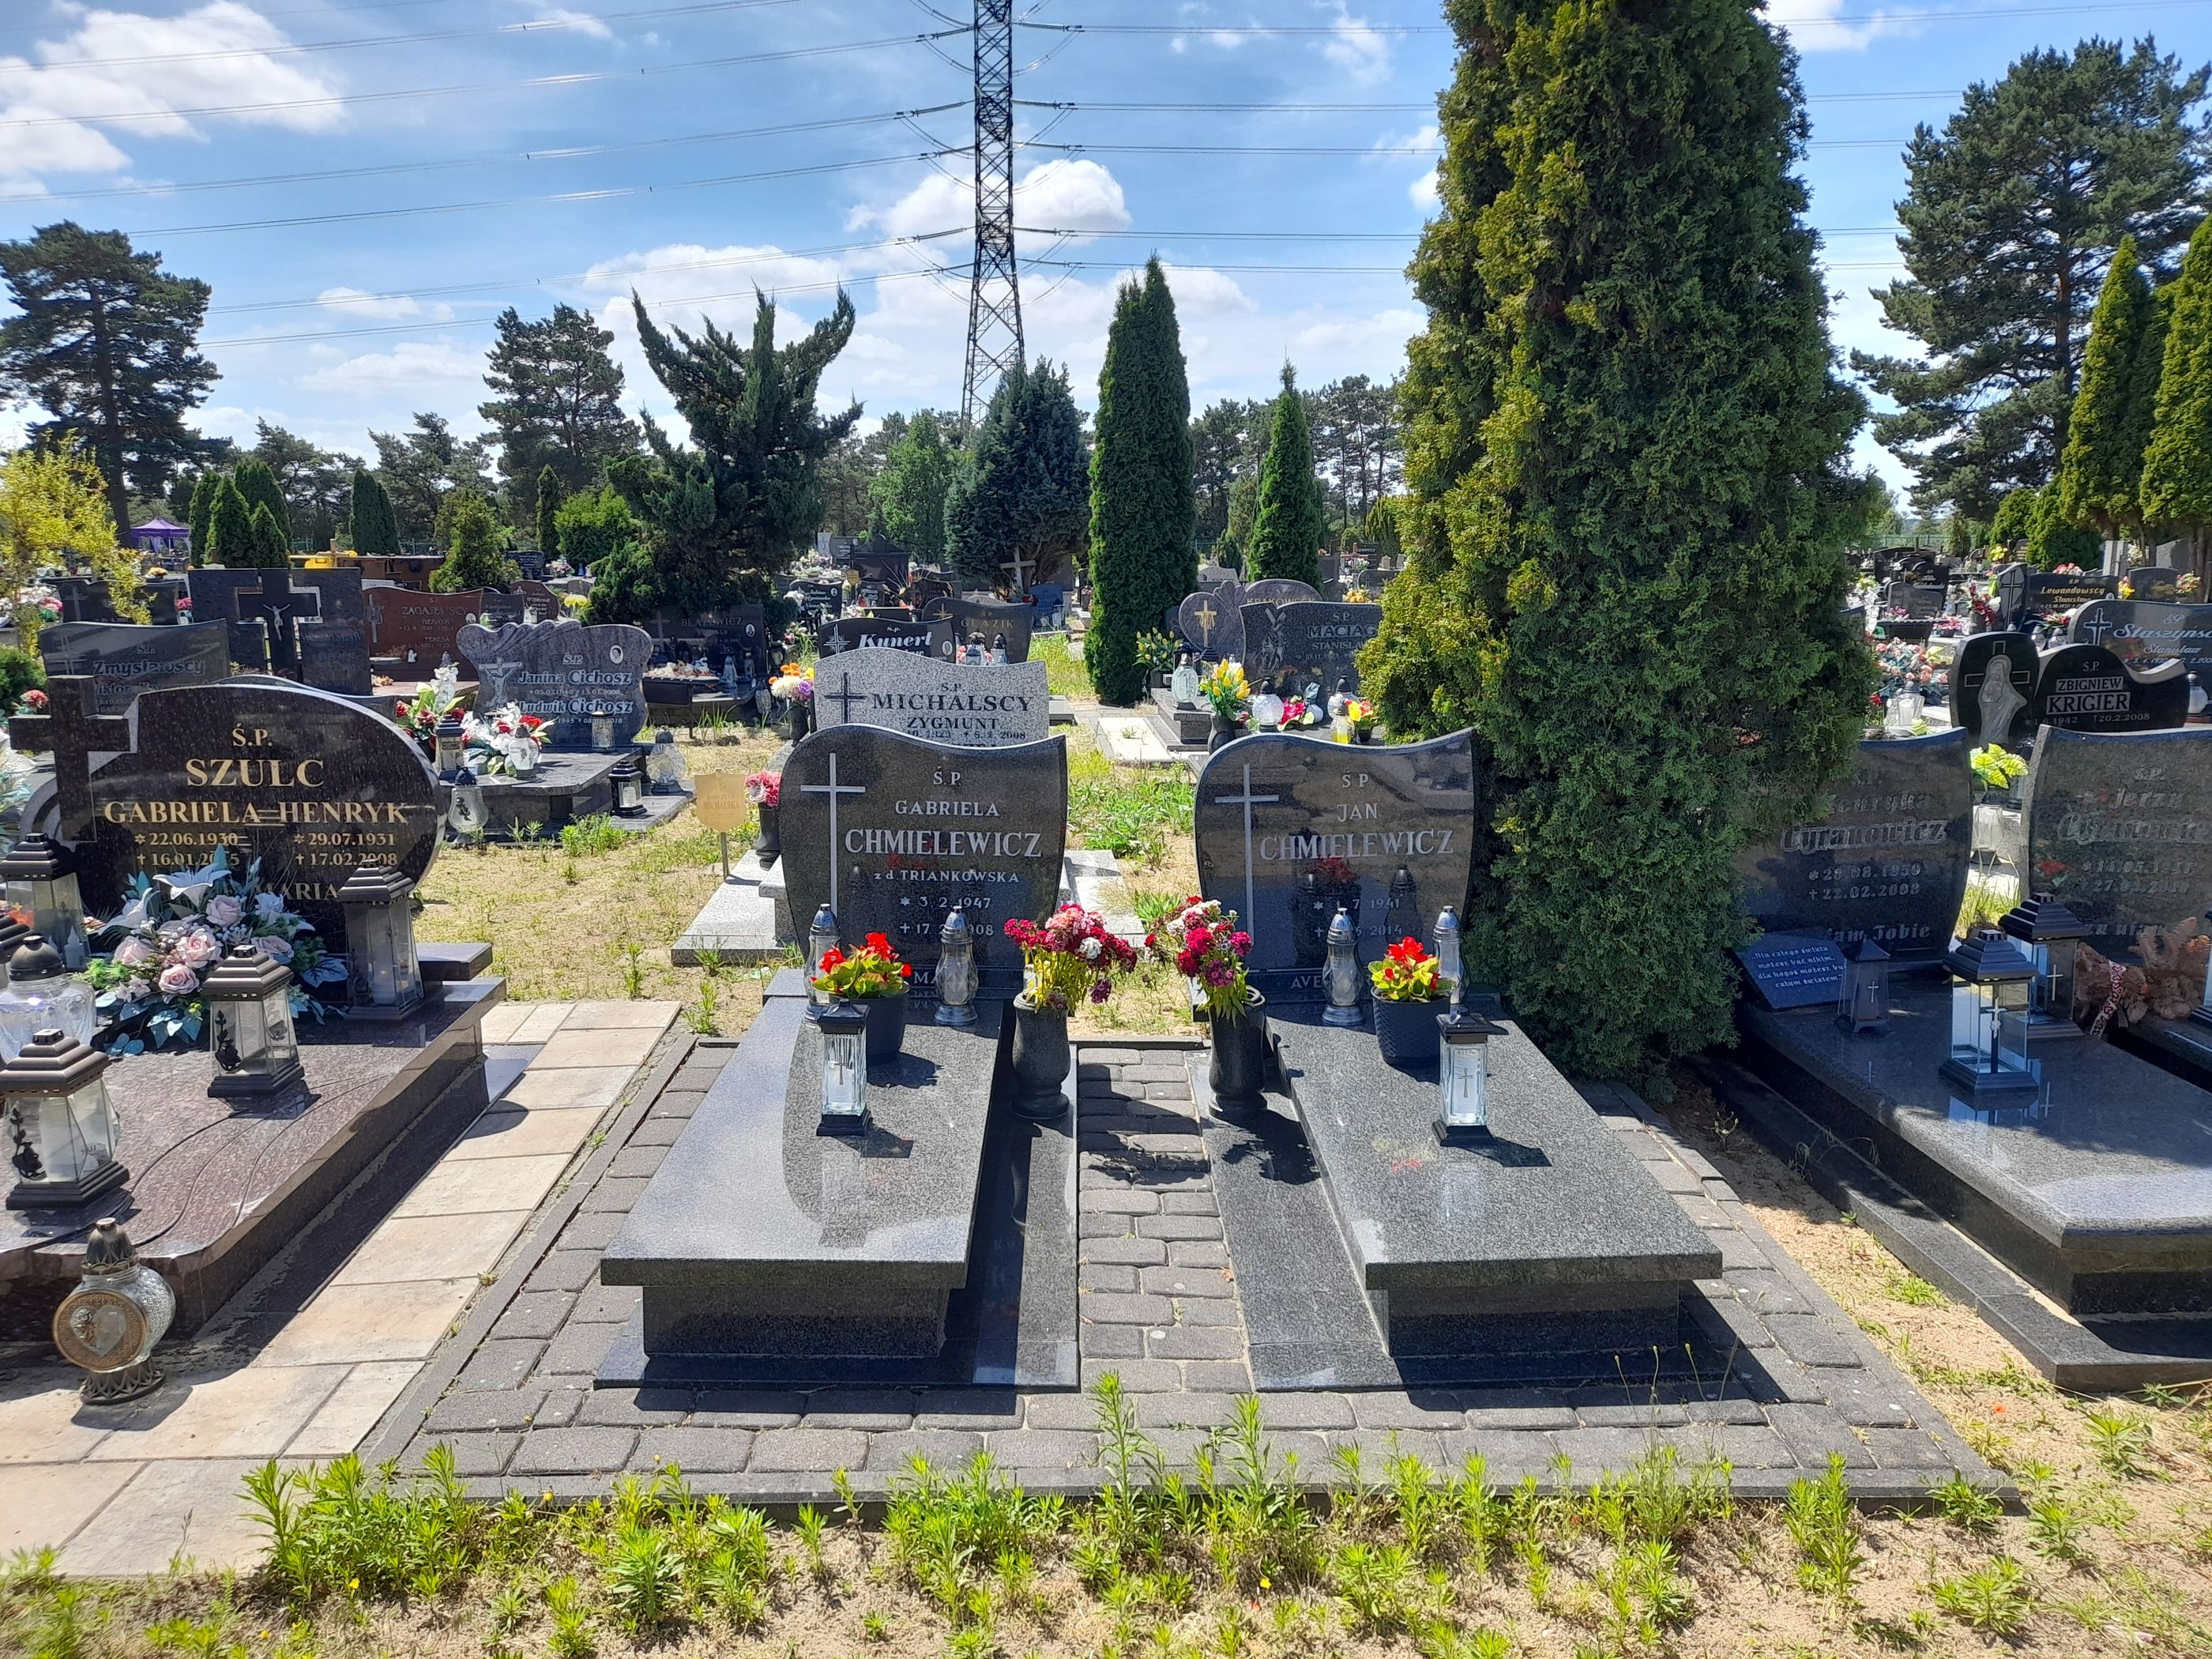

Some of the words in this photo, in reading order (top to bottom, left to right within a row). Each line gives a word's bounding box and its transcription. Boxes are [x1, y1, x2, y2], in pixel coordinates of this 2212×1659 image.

[2041, 586, 2105, 595] Lewandowscy
[858, 632, 933, 649] Kunert
[518, 672, 566, 685] Janina
[568, 669, 633, 686] Cichosz
[2058, 678, 2122, 692] ZBIGNIEW
[519, 699, 566, 713] Ludwik
[567, 695, 634, 714] Cichosz
[871, 693, 1033, 712] MICHALSCY
[2048, 694, 2128, 713] KRIGIER
[907, 717, 999, 730] ZYGMUNT
[231, 723, 273, 747] Ś.P.
[186, 758, 325, 788] SZULC
[103, 800, 261, 824] GABRIELA
[277, 801, 409, 824] HENRYK
[895, 799, 1000, 817] GABRIELA
[1336, 803, 1378, 822] JAN
[308, 832, 397, 846] 29.07.1931
[845, 829, 1043, 858] CHMIELEWICZ
[1259, 828, 1454, 860] CHMIELEWICZ
[1291, 975, 1322, 988] AVE
